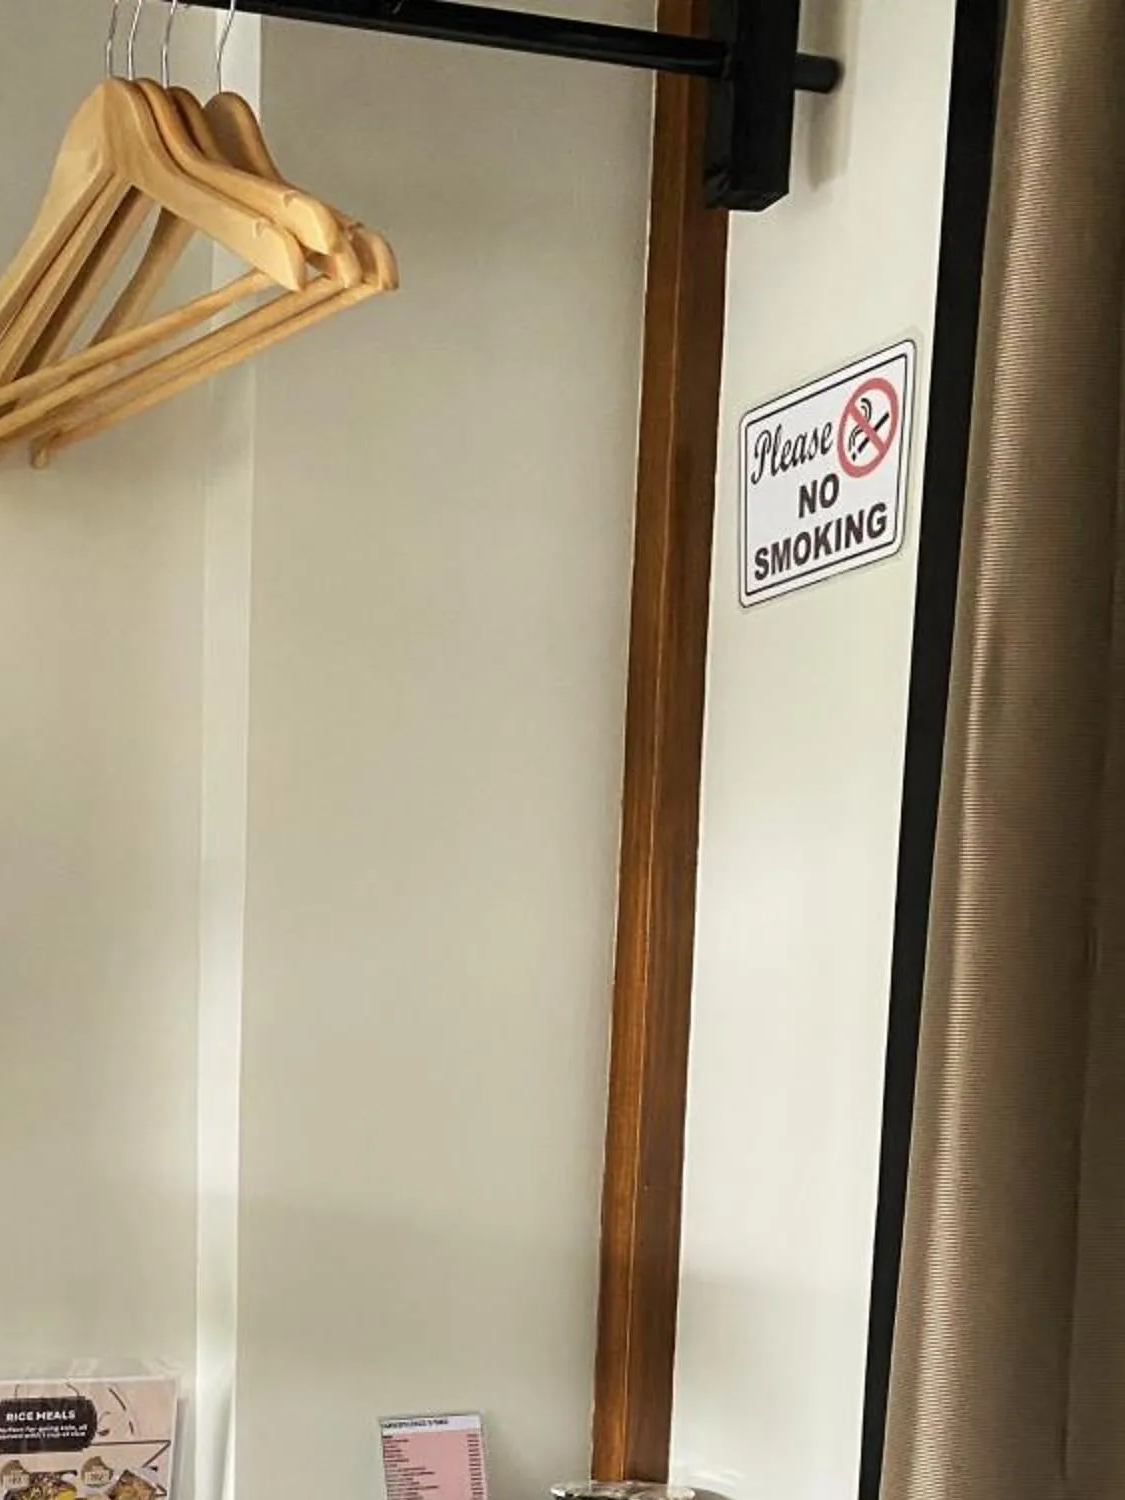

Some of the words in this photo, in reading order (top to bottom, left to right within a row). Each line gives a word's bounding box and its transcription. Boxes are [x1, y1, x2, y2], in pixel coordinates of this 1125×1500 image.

[751, 422, 834, 485] Please
[798, 473, 840, 518] NO
[754, 502, 888, 581] SMOKING
[6, 1411, 34, 1421] RICE
[36, 1410, 76, 1421] MEALS
